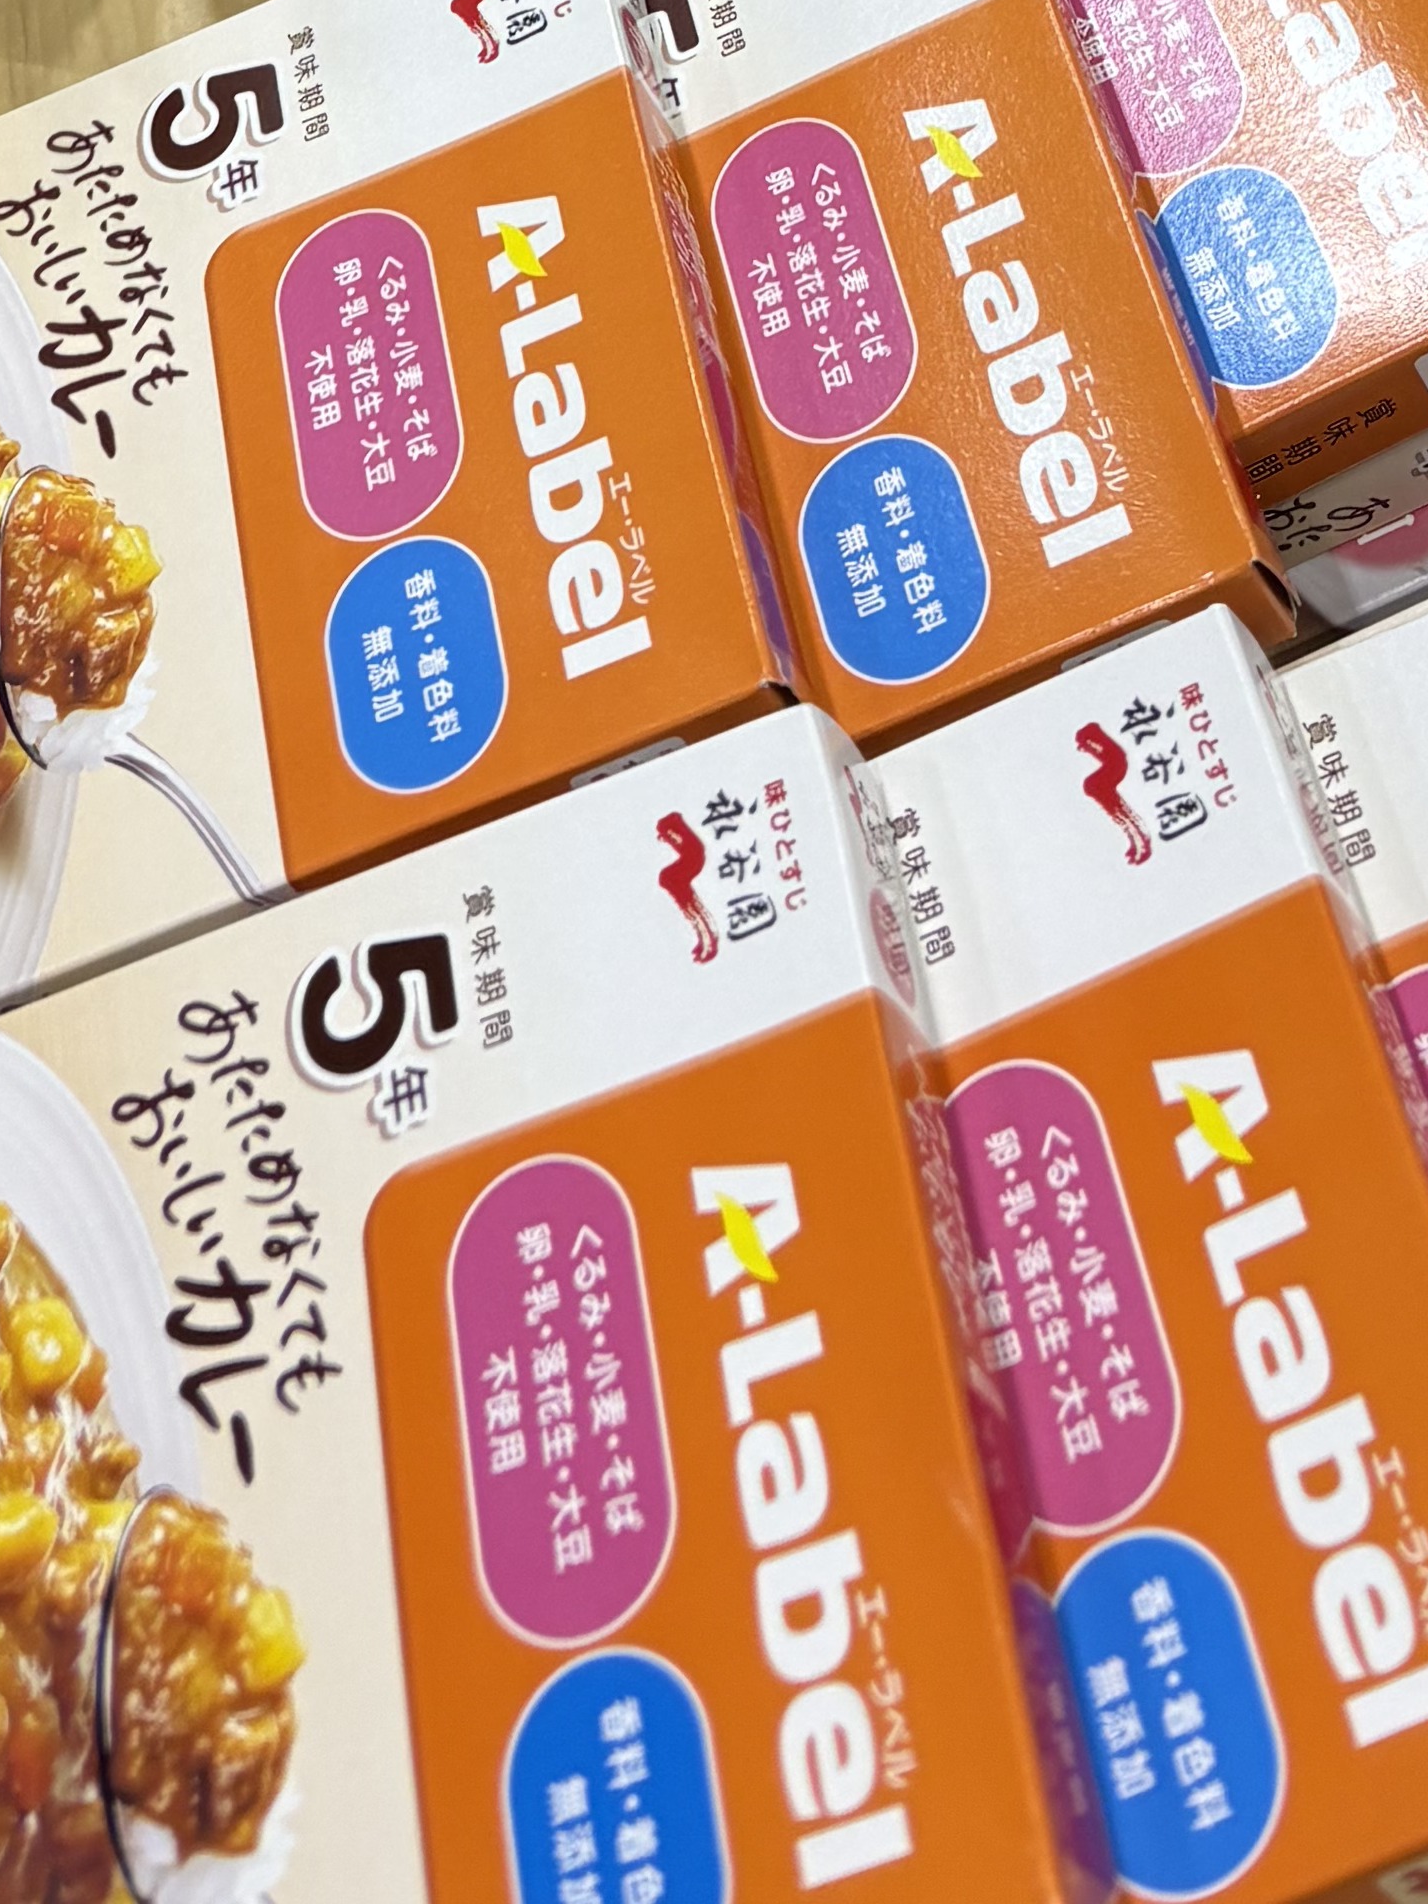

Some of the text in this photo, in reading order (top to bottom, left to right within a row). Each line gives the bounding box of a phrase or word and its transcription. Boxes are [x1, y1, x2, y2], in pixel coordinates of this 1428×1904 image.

[288, 25, 331, 142] 賞味期間
[47, 120, 191, 405] あたためなくても
[748, 257, 792, 338] 不使用
[306, 349, 338, 429] 不使用
[836, 527, 881, 618] 無添加
[873, 467, 948, 633] 香料・着色料
[360, 625, 404, 722] 無添加
[404, 569, 462, 741] 香料・着色料
[1302, 711, 1377, 869] 賞味期間
[887, 806, 955, 965] 賞味期間
[462, 884, 512, 1049] 賞味期間
[111, 1070, 266, 1485] おいしいカレー
[178, 989, 342, 1414] あたためなくても
[481, 1347, 526, 1473] 不使用
[691, 1163, 912, 1890] A-Label
